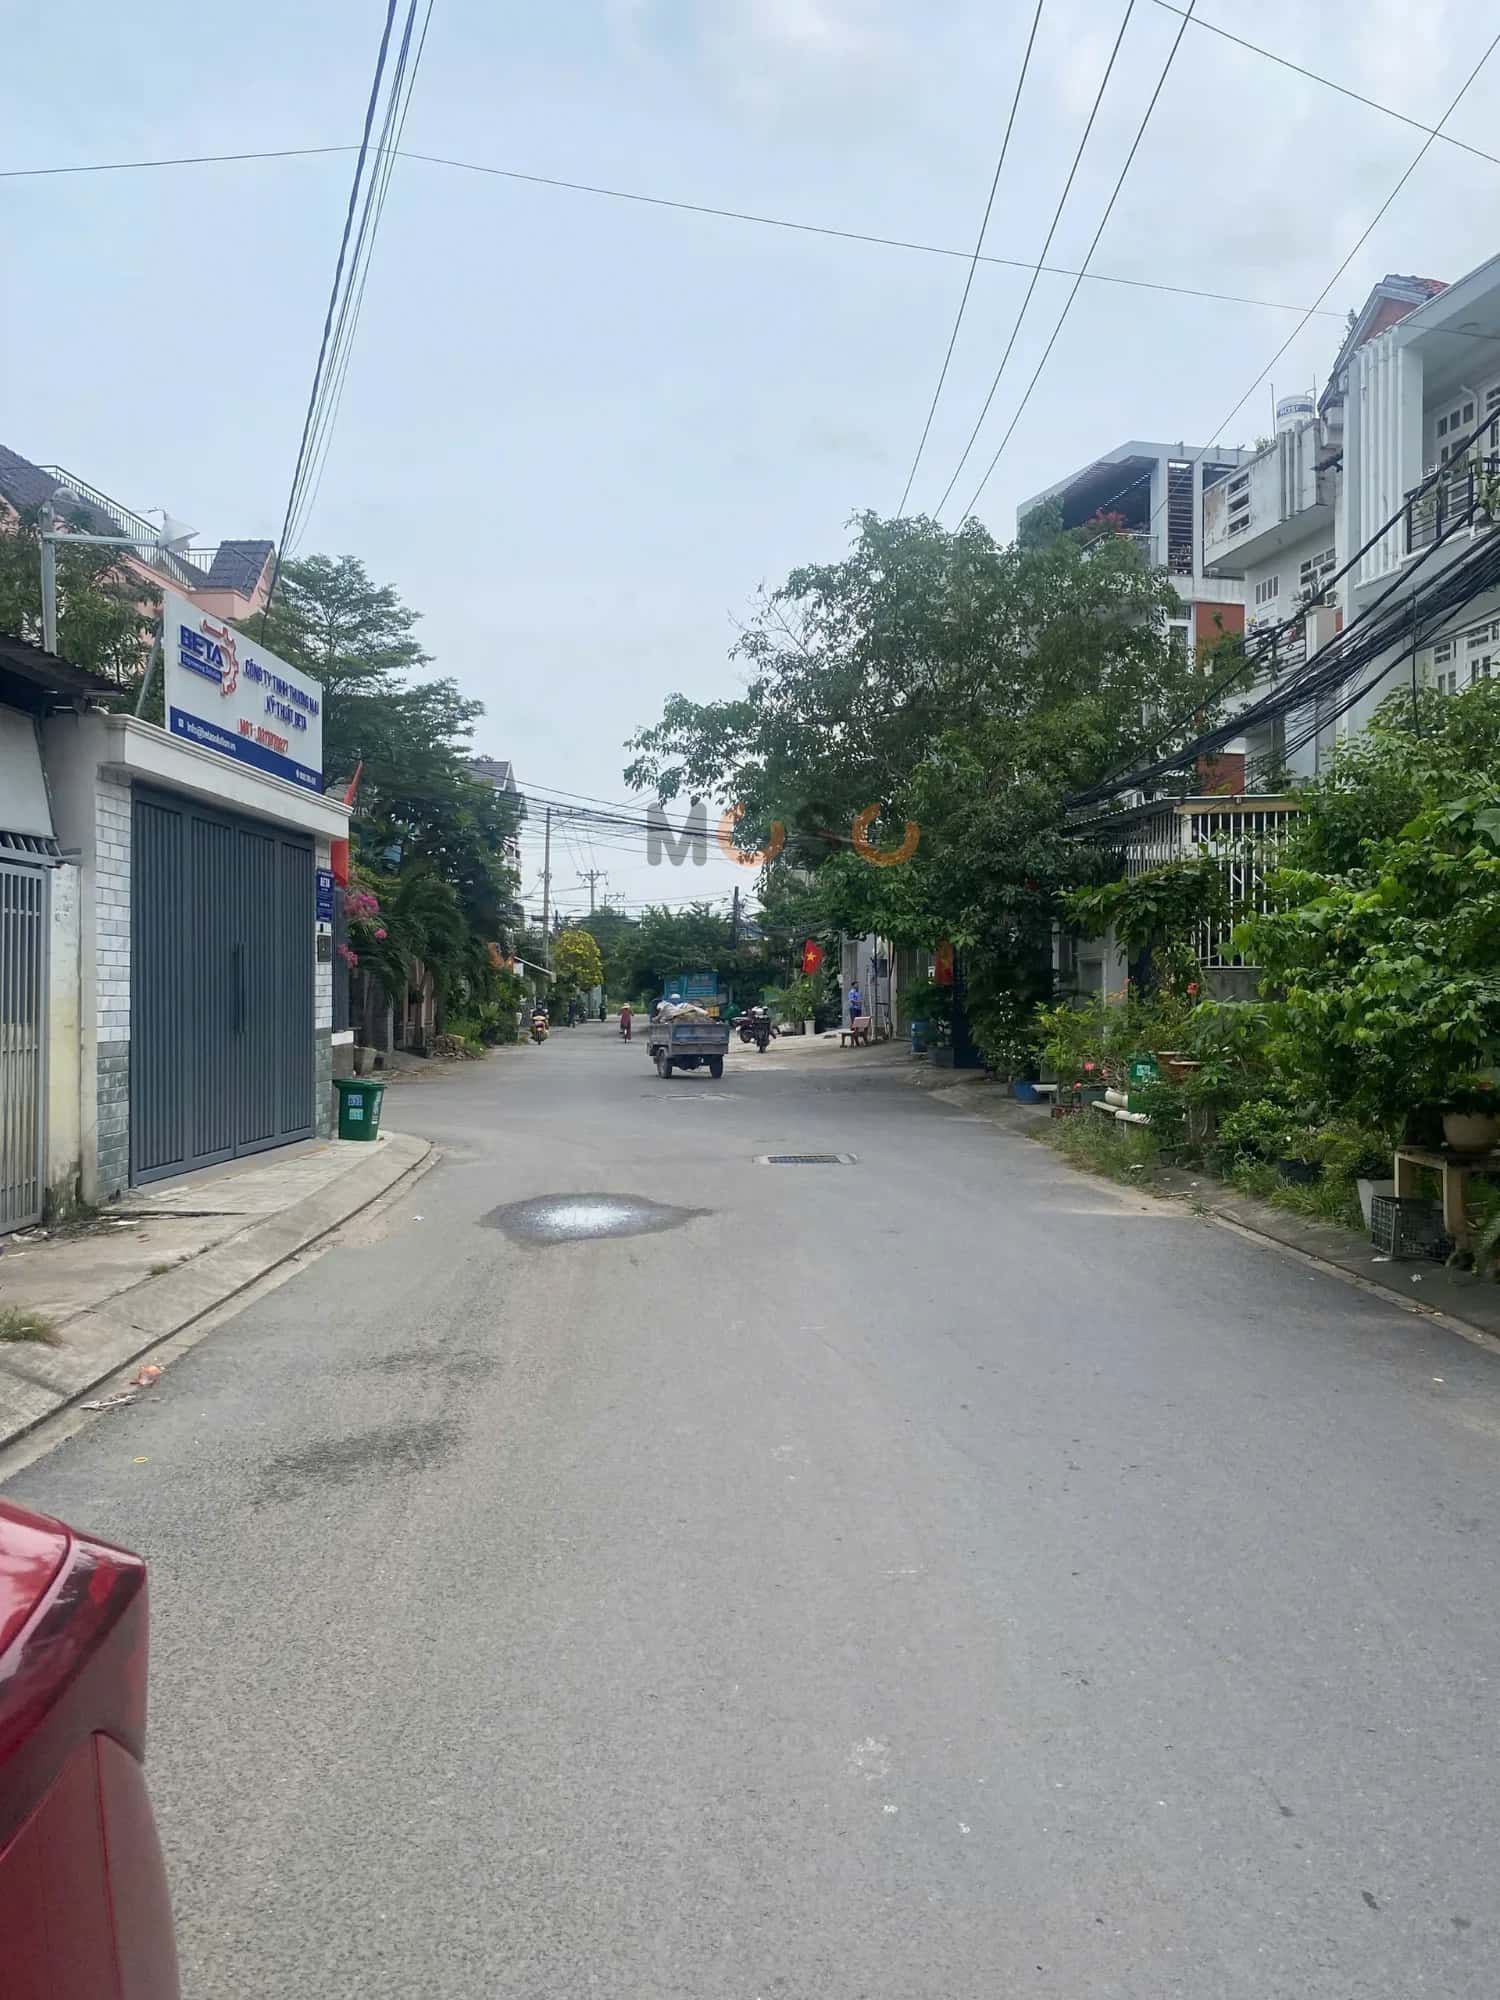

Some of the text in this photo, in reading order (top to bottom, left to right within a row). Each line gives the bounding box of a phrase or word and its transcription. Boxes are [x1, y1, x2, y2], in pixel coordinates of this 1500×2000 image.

[180, 624, 224, 667] BETA
[245, 658, 263, 682] CÔNG
[263, 669, 272, 687] TY
[272, 675, 289, 697] TNHH
[294, 711, 307, 730] BETA
